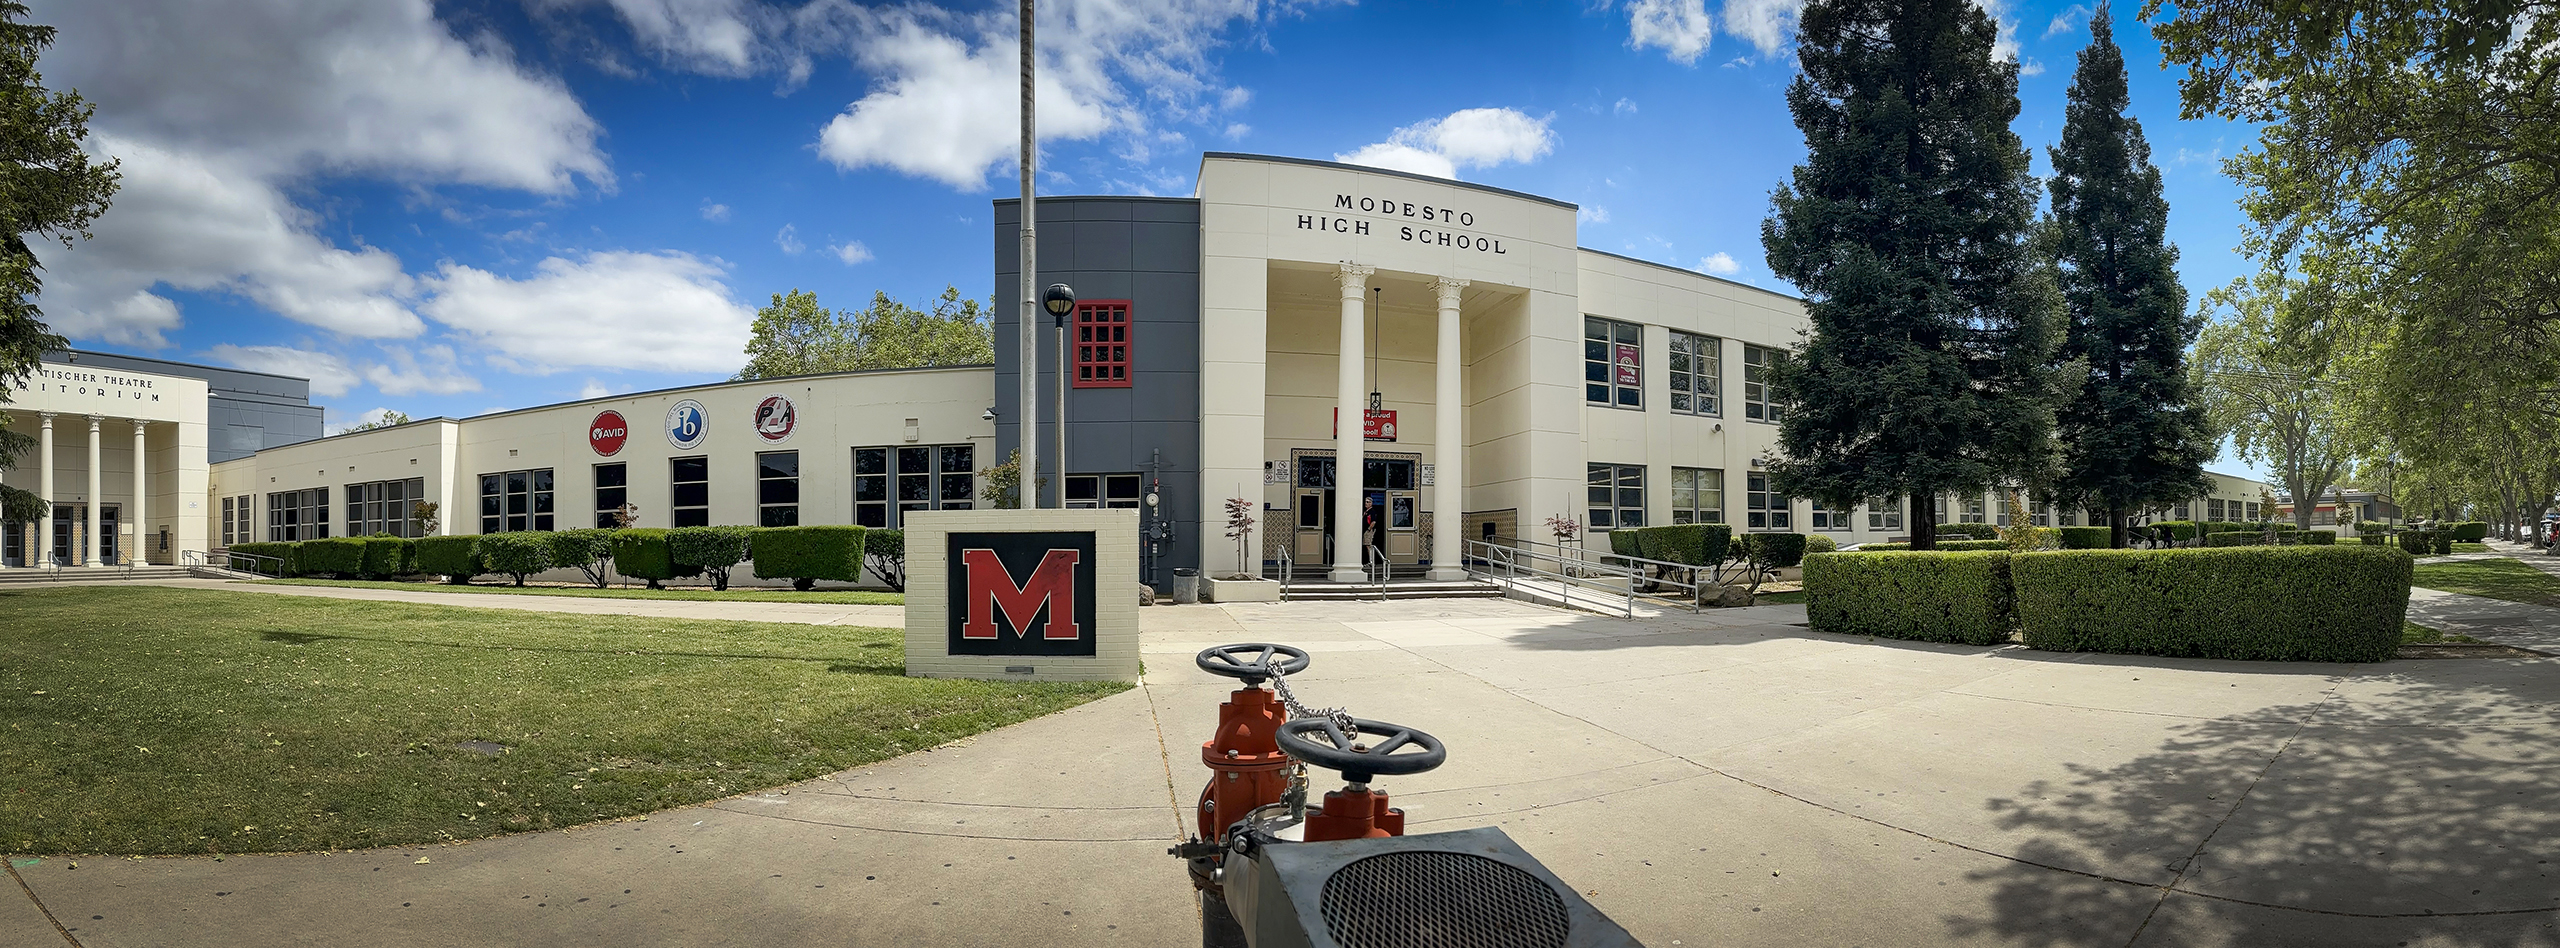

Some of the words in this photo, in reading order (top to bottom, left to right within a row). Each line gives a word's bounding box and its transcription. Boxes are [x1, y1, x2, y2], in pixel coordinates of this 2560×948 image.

[1334, 194, 1474, 226] MODESTO
[1297, 214, 1370, 236] HIGH
[1400, 226, 1507, 254] SCHOOL
[19, 381, 160, 402] DITORIUM
[43, 369, 97, 383] TISCHER
[104, 375, 153, 388] THEATRE
[602, 427, 625, 439] AVID
[963, 549, 1079, 640] M
